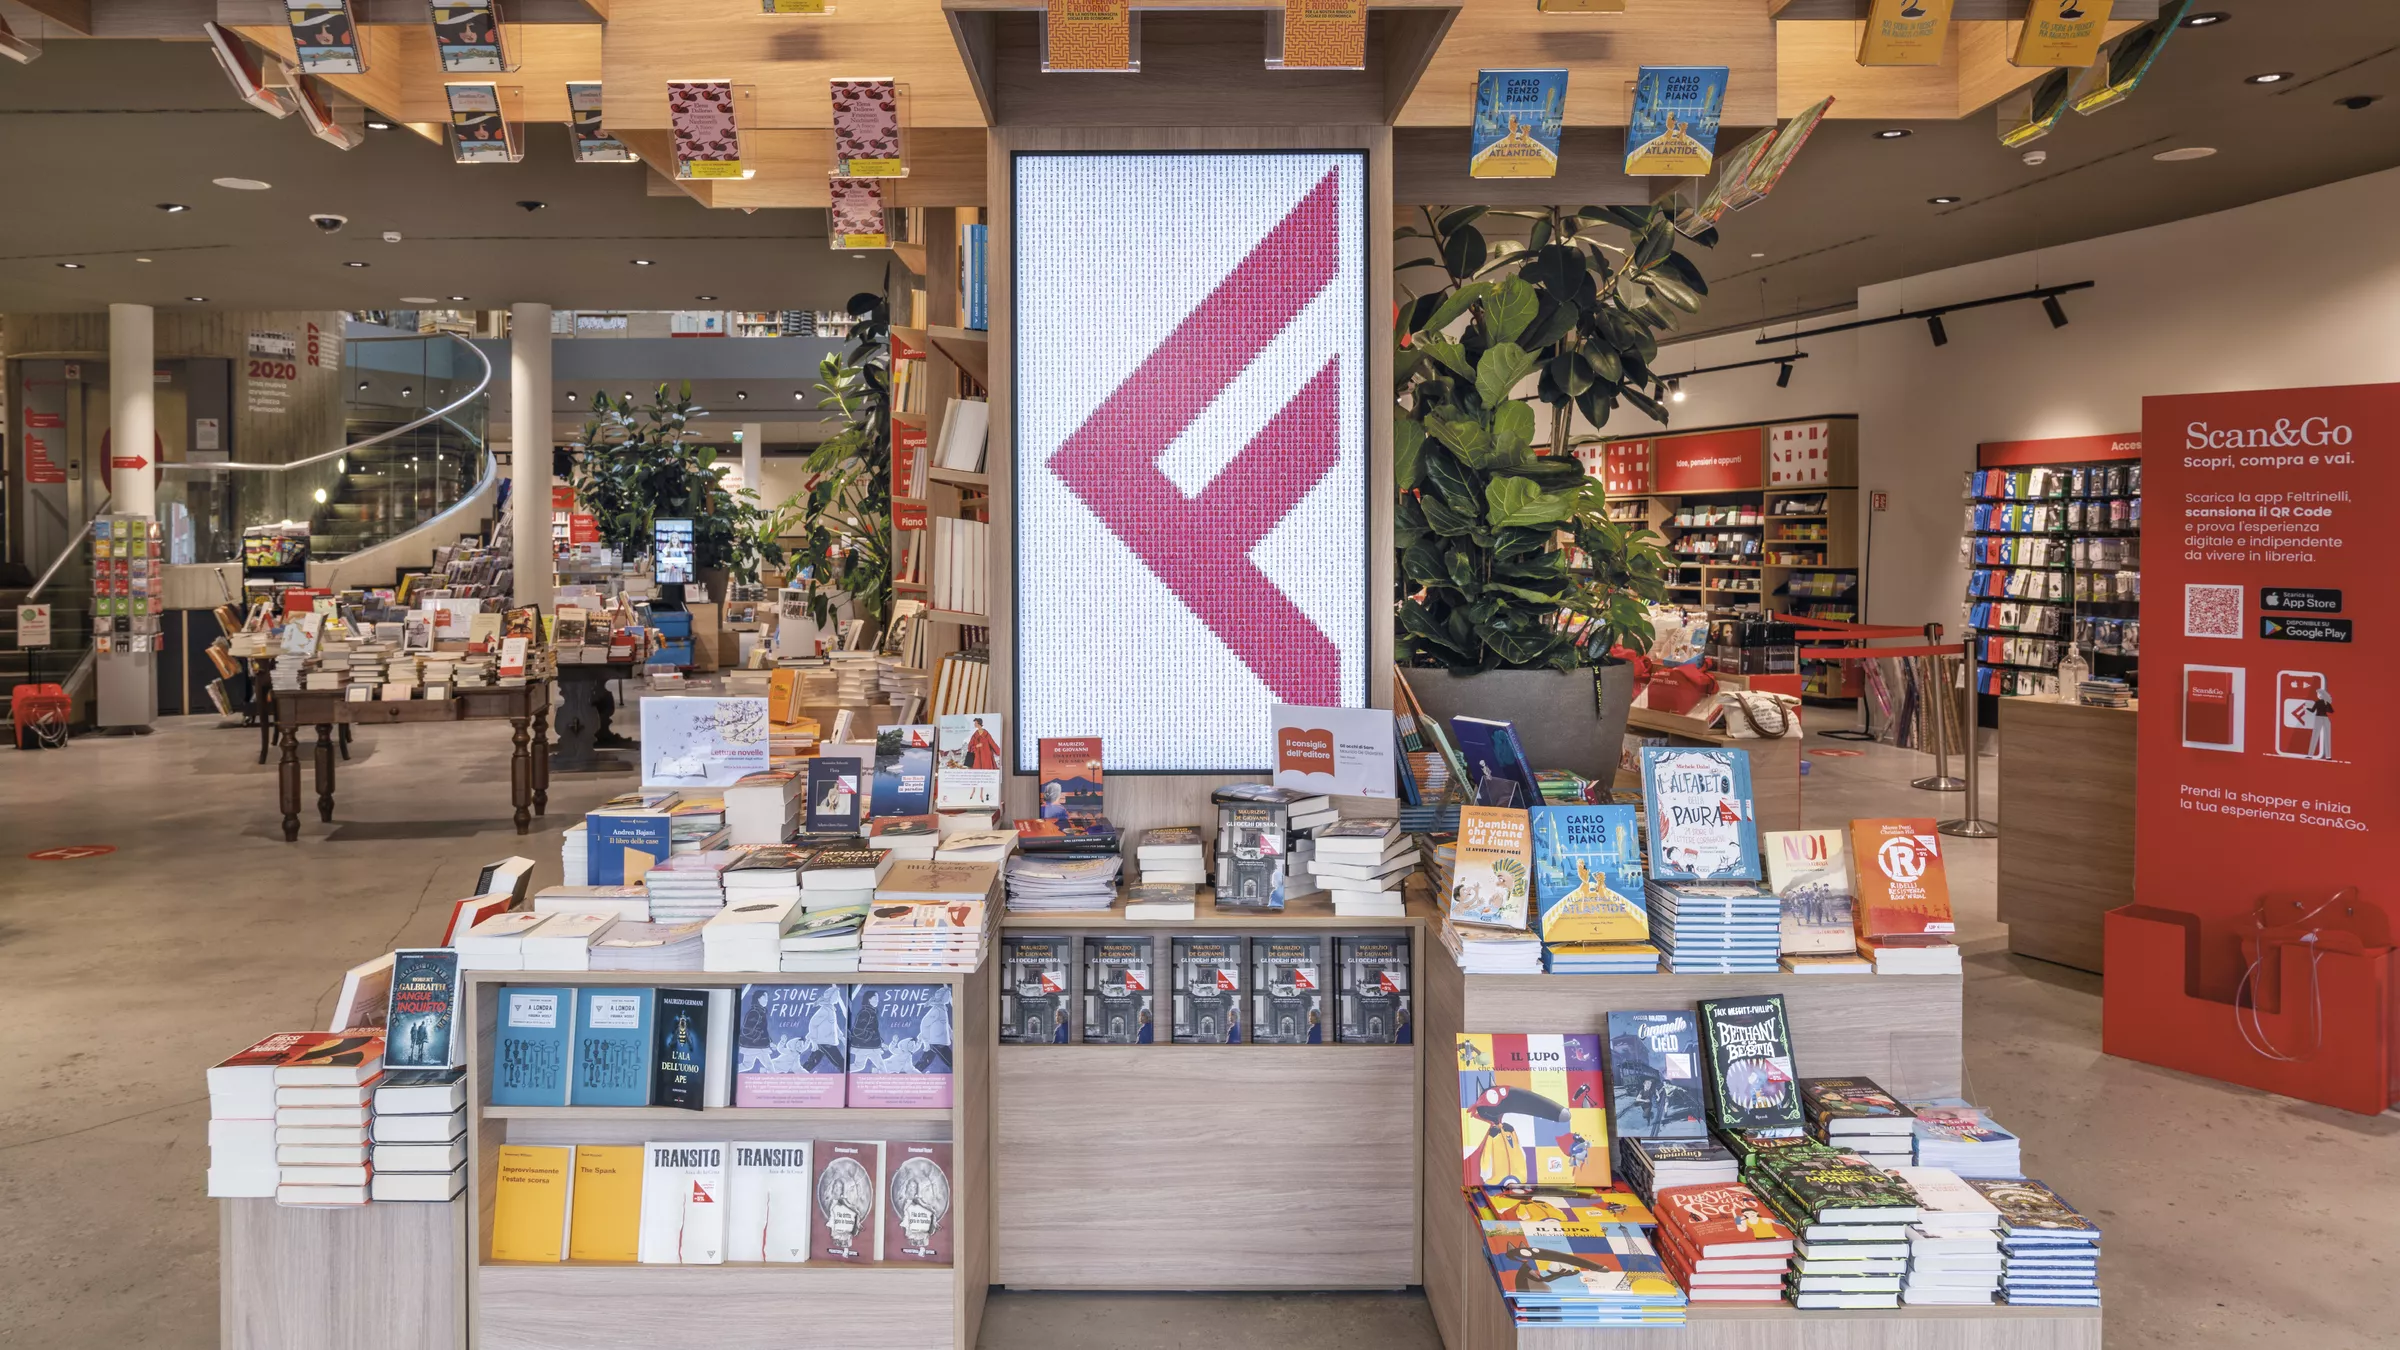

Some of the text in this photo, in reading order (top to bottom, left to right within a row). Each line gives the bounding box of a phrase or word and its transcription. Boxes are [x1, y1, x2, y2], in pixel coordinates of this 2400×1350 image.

[1507, 79, 1540, 87] CARLO
[1668, 76, 1700, 84] CARLO
[1507, 87, 1540, 95] RENZO
[1667, 84, 1699, 92] RENZO
[1506, 94, 1539, 103] PIANO
[1665, 92, 1698, 100] PIANO
[1489, 149, 1542, 157] ATLANTIDE
[1645, 146, 1698, 155] ATLANTIDE
[307, 322, 319, 367] 2017
[248, 360, 296, 380] 2020
[2186, 417, 2353, 450] Scan&Go
[1676, 460, 1690, 468] Idee,
[1690, 457, 1713, 468] pensieri
[1718, 455, 1742, 467] appunti
[2184, 452, 2355, 470] Scopri, compra e vai.
[2185, 491, 2351, 505] Scarica la app Feltrinelli,
[2185, 506, 2332, 518] scansiona il QR Code
[902, 518, 923, 527] Piano
[2185, 521, 2319, 534] e prova l'esperienza
[2185, 535, 2343, 549] digitale e indipendente
[2185, 550, 2316, 562] da vivere in libreria.
[2283, 598, 2336, 609] App Store
[2286, 626, 2347, 640] Google Play
[2192, 686, 2224, 695] Scan&Go
[1291, 740, 1327, 750] consiglio
[1286, 749, 1330, 759] dell'editore
[2180, 784, 2351, 814] Prendi la shopper e inizia
[1567, 815, 1604, 824] CARLO
[1671, 805, 1724, 828] PAURA
[2180, 798, 2370, 832] la tua esperienza Scan&Go.
[1467, 819, 1525, 832] Il bambino
[1568, 825, 1605, 834] RENZO
[636, 829, 656, 837] Bajani
[1468, 828, 1523, 839] che venne
[1469, 836, 1520, 848] dal fiume
[1569, 835, 1606, 844] PIANO
[1783, 834, 1828, 861] NOI
[1561, 903, 1627, 914] ATLANTIDE
[399, 983, 446, 991] GALBRAITH
[397, 992, 431, 1001] SANGUE
[772, 988, 818, 1001] STONE
[883, 989, 929, 1001] STONE
[397, 1002, 447, 1013] INQUIETO
[770, 1003, 813, 1017] FRUIT
[881, 1004, 925, 1018] FRUIT
[1714, 1007, 1727, 1017] JACK
[1717, 1017, 1778, 1046] BETHANY
[1652, 1034, 1679, 1052] CIELO
[672, 1051, 691, 1060] L'ALA
[1511, 1052, 1559, 1061] IL LUPO
[1728, 1042, 1775, 1063] BESTIA
[661, 1062, 699, 1073] DELL'UOMO
[674, 1075, 687, 1084] APE
[654, 1149, 720, 1167] TRANSITO
[737, 1148, 804, 1167] TRANSITO
[503, 1166, 559, 1175] Improvvisamente
[581, 1166, 617, 1175] The Spank
[1805, 1174, 1886, 1184] MONKEYS
[1672, 1190, 1731, 1208] PRESTA
[1684, 1197, 1758, 1224] SOGNO
